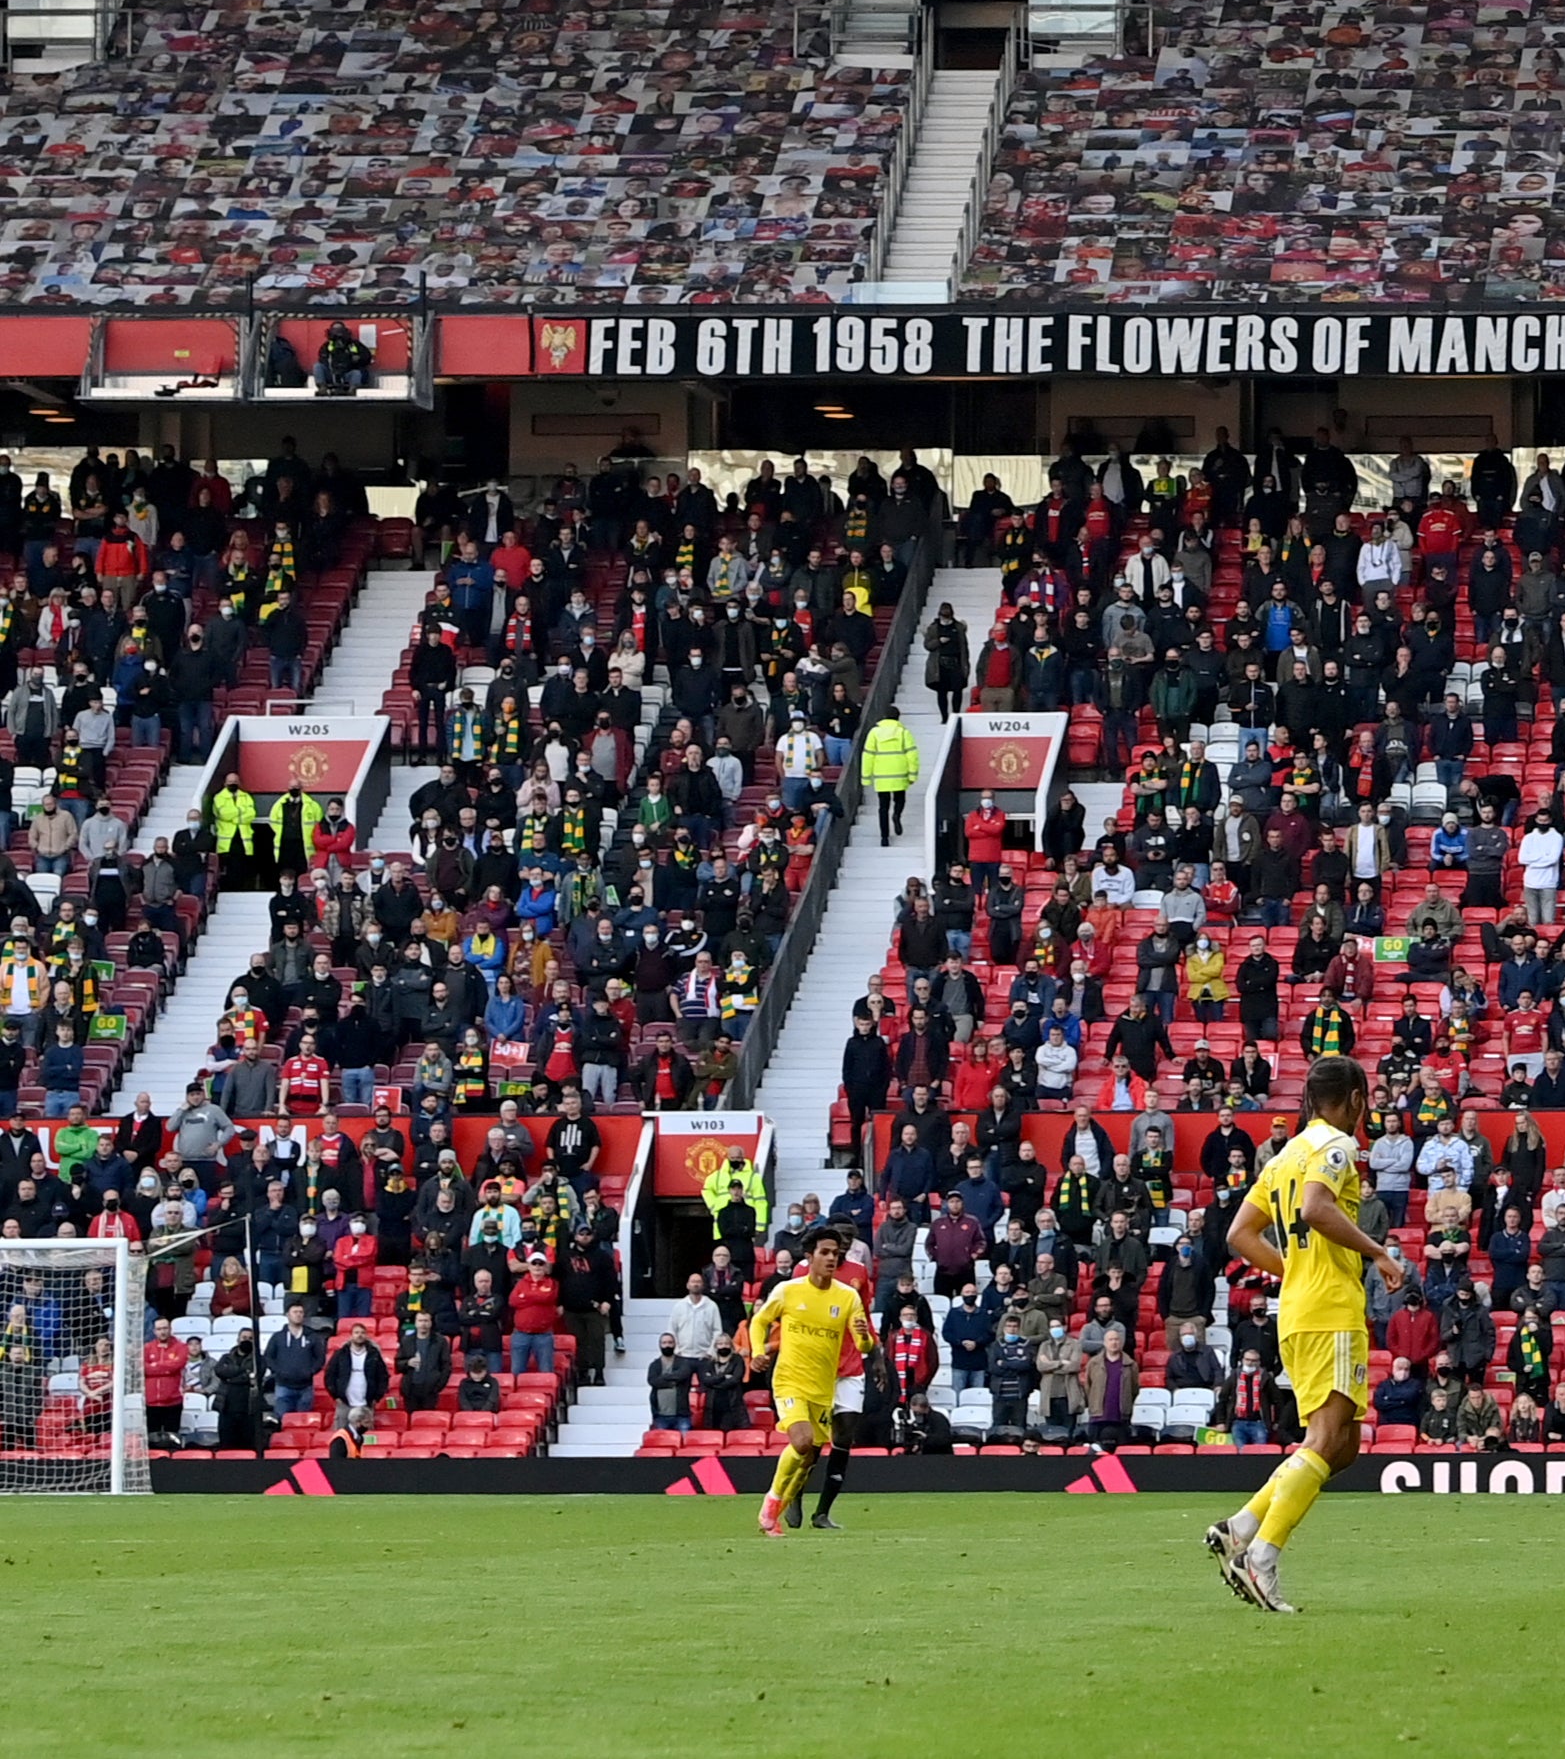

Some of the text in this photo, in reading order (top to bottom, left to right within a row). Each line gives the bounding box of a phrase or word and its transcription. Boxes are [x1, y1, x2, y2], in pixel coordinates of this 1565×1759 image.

[588, 317, 675, 376] FEB
[697, 317, 794, 374] 6TH
[813, 315, 933, 374] 1958
[963, 316, 1053, 374] THE
[1067, 314, 1297, 374] FLOWERS
[1313, 316, 1370, 373] OF
[288, 725, 329, 735] W205
[989, 721, 1030, 732] W204
[1384, 938, 1404, 951] GO
[98, 1017, 116, 1029] GO
[494, 1039, 525, 1056] 50+1
[691, 1120, 725, 1130] W103
[1270, 1178, 1311, 1260] 14
[787, 1322, 840, 1341] BETVICTOR
[1205, 1430, 1227, 1445] GO
